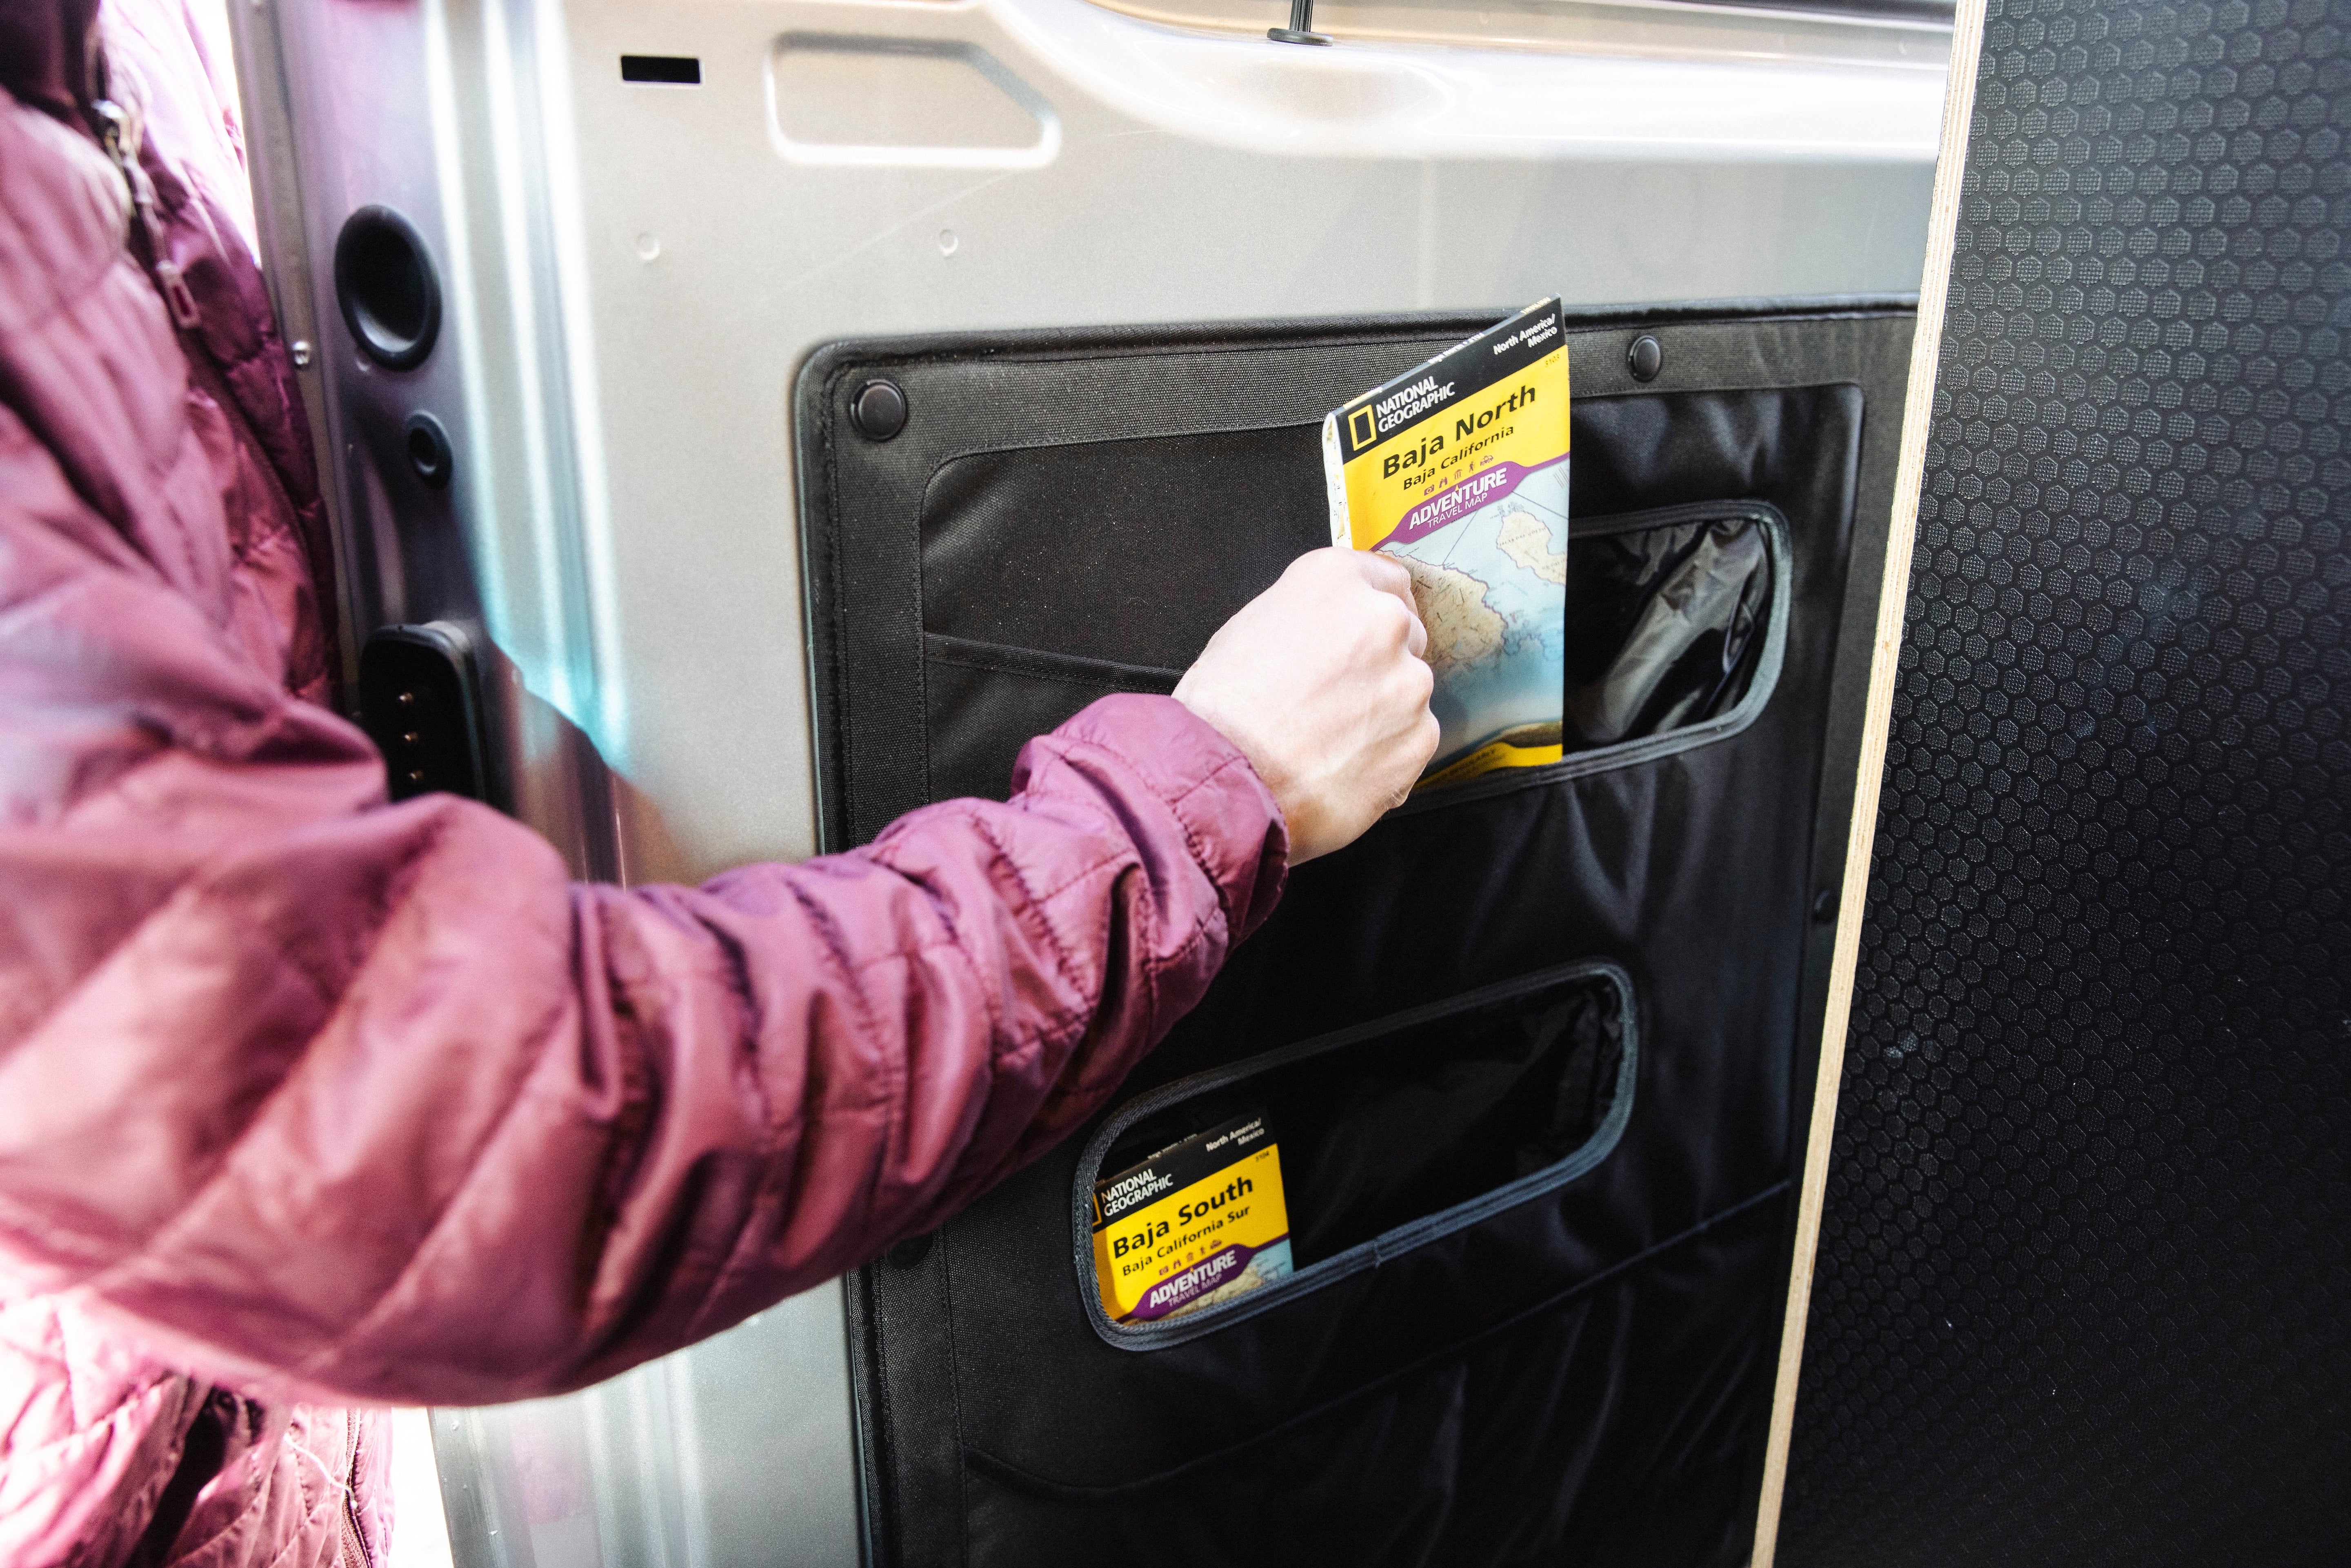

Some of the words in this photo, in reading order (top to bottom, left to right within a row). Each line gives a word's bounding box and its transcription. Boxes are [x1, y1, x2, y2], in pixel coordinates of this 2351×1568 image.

[1493, 335, 1519, 355] North
[1527, 326, 1558, 347] Mexico
[1376, 376, 1438, 418] NATIONAL
[1378, 382, 1455, 432] GEOGRAPHIC
[1384, 435, 1444, 480] Baja
[1456, 385, 1535, 442] North
[1404, 468, 1435, 490] Baja
[1441, 426, 1513, 469] California
[1409, 467, 1507, 530] ADVENTURE
[1427, 506, 1463, 528] TRAVEL
[1465, 492, 1488, 509] MAP
[1206, 1135, 1229, 1152] North
[1238, 1128, 1264, 1146] Mexico
[1101, 1168, 1157, 1204] NATIONAL
[1104, 1173, 1173, 1216] GEOGRAPHIC
[1113, 1221, 1169, 1259] Baja
[1178, 1176, 1253, 1226] South
[1123, 1256, 1153, 1276] Baja
[1157, 1219, 1223, 1258] California
[1228, 1205, 1250, 1223] Sur
[1150, 1249, 1237, 1308] ADVENTURE
[1167, 1286, 1200, 1307] TRAVEL
[1201, 1273, 1222, 1290] MAP
